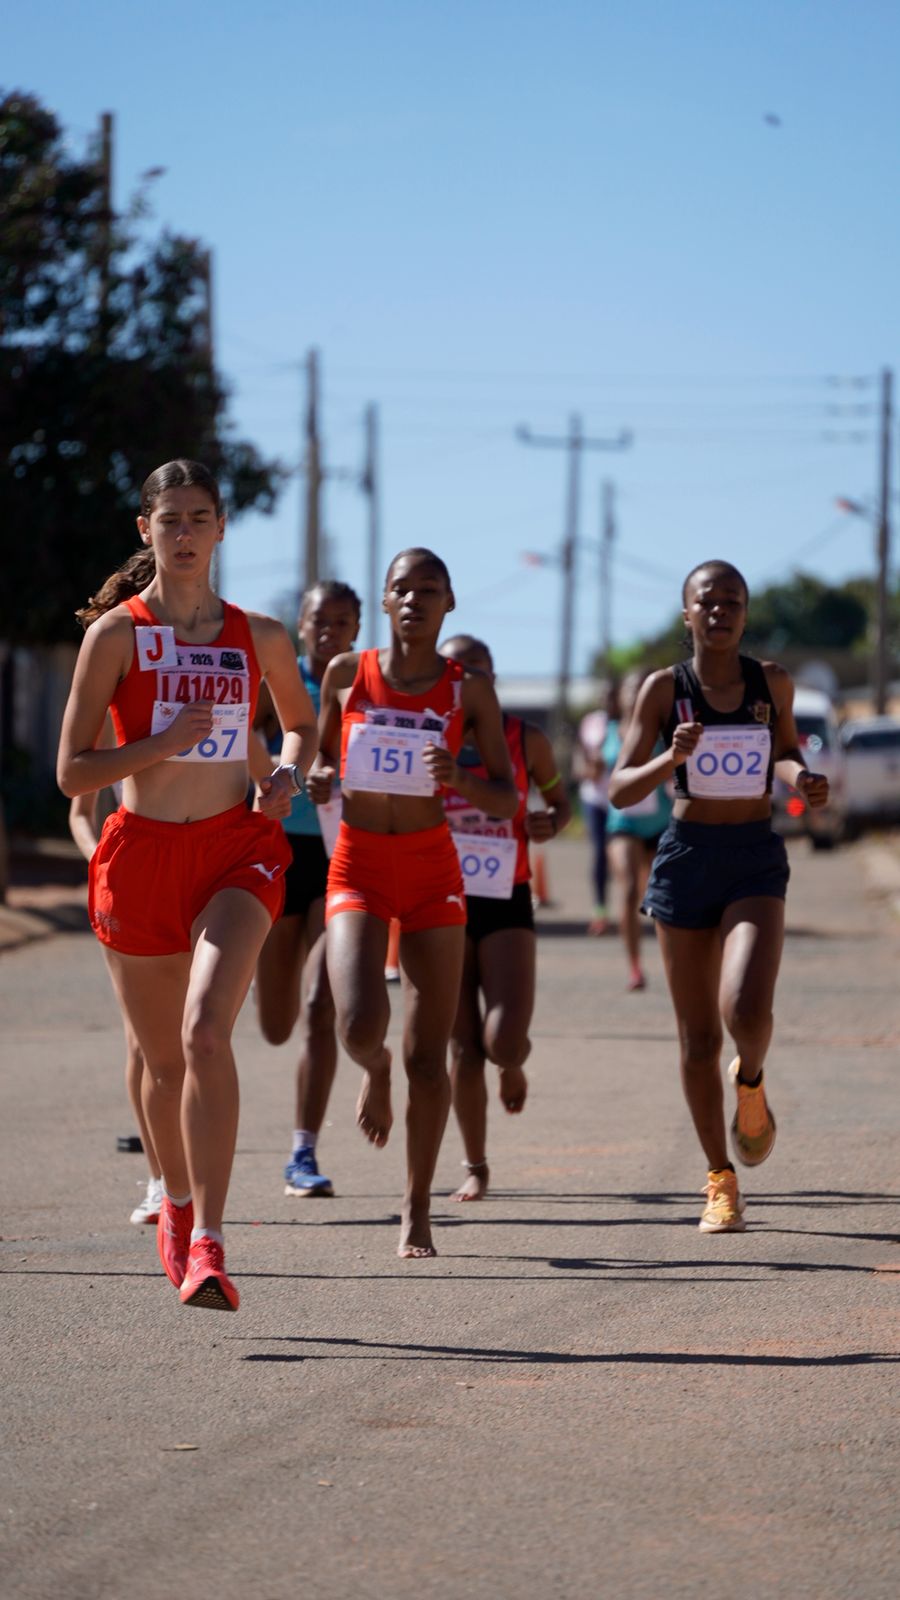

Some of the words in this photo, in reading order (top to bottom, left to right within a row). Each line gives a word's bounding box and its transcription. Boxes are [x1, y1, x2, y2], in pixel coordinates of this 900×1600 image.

[146, 632, 164, 662] J
[190, 653, 214, 666] 2026
[176, 729, 239, 758] 67
[371, 747, 413, 775] 151
[696, 751, 762, 776] 002
